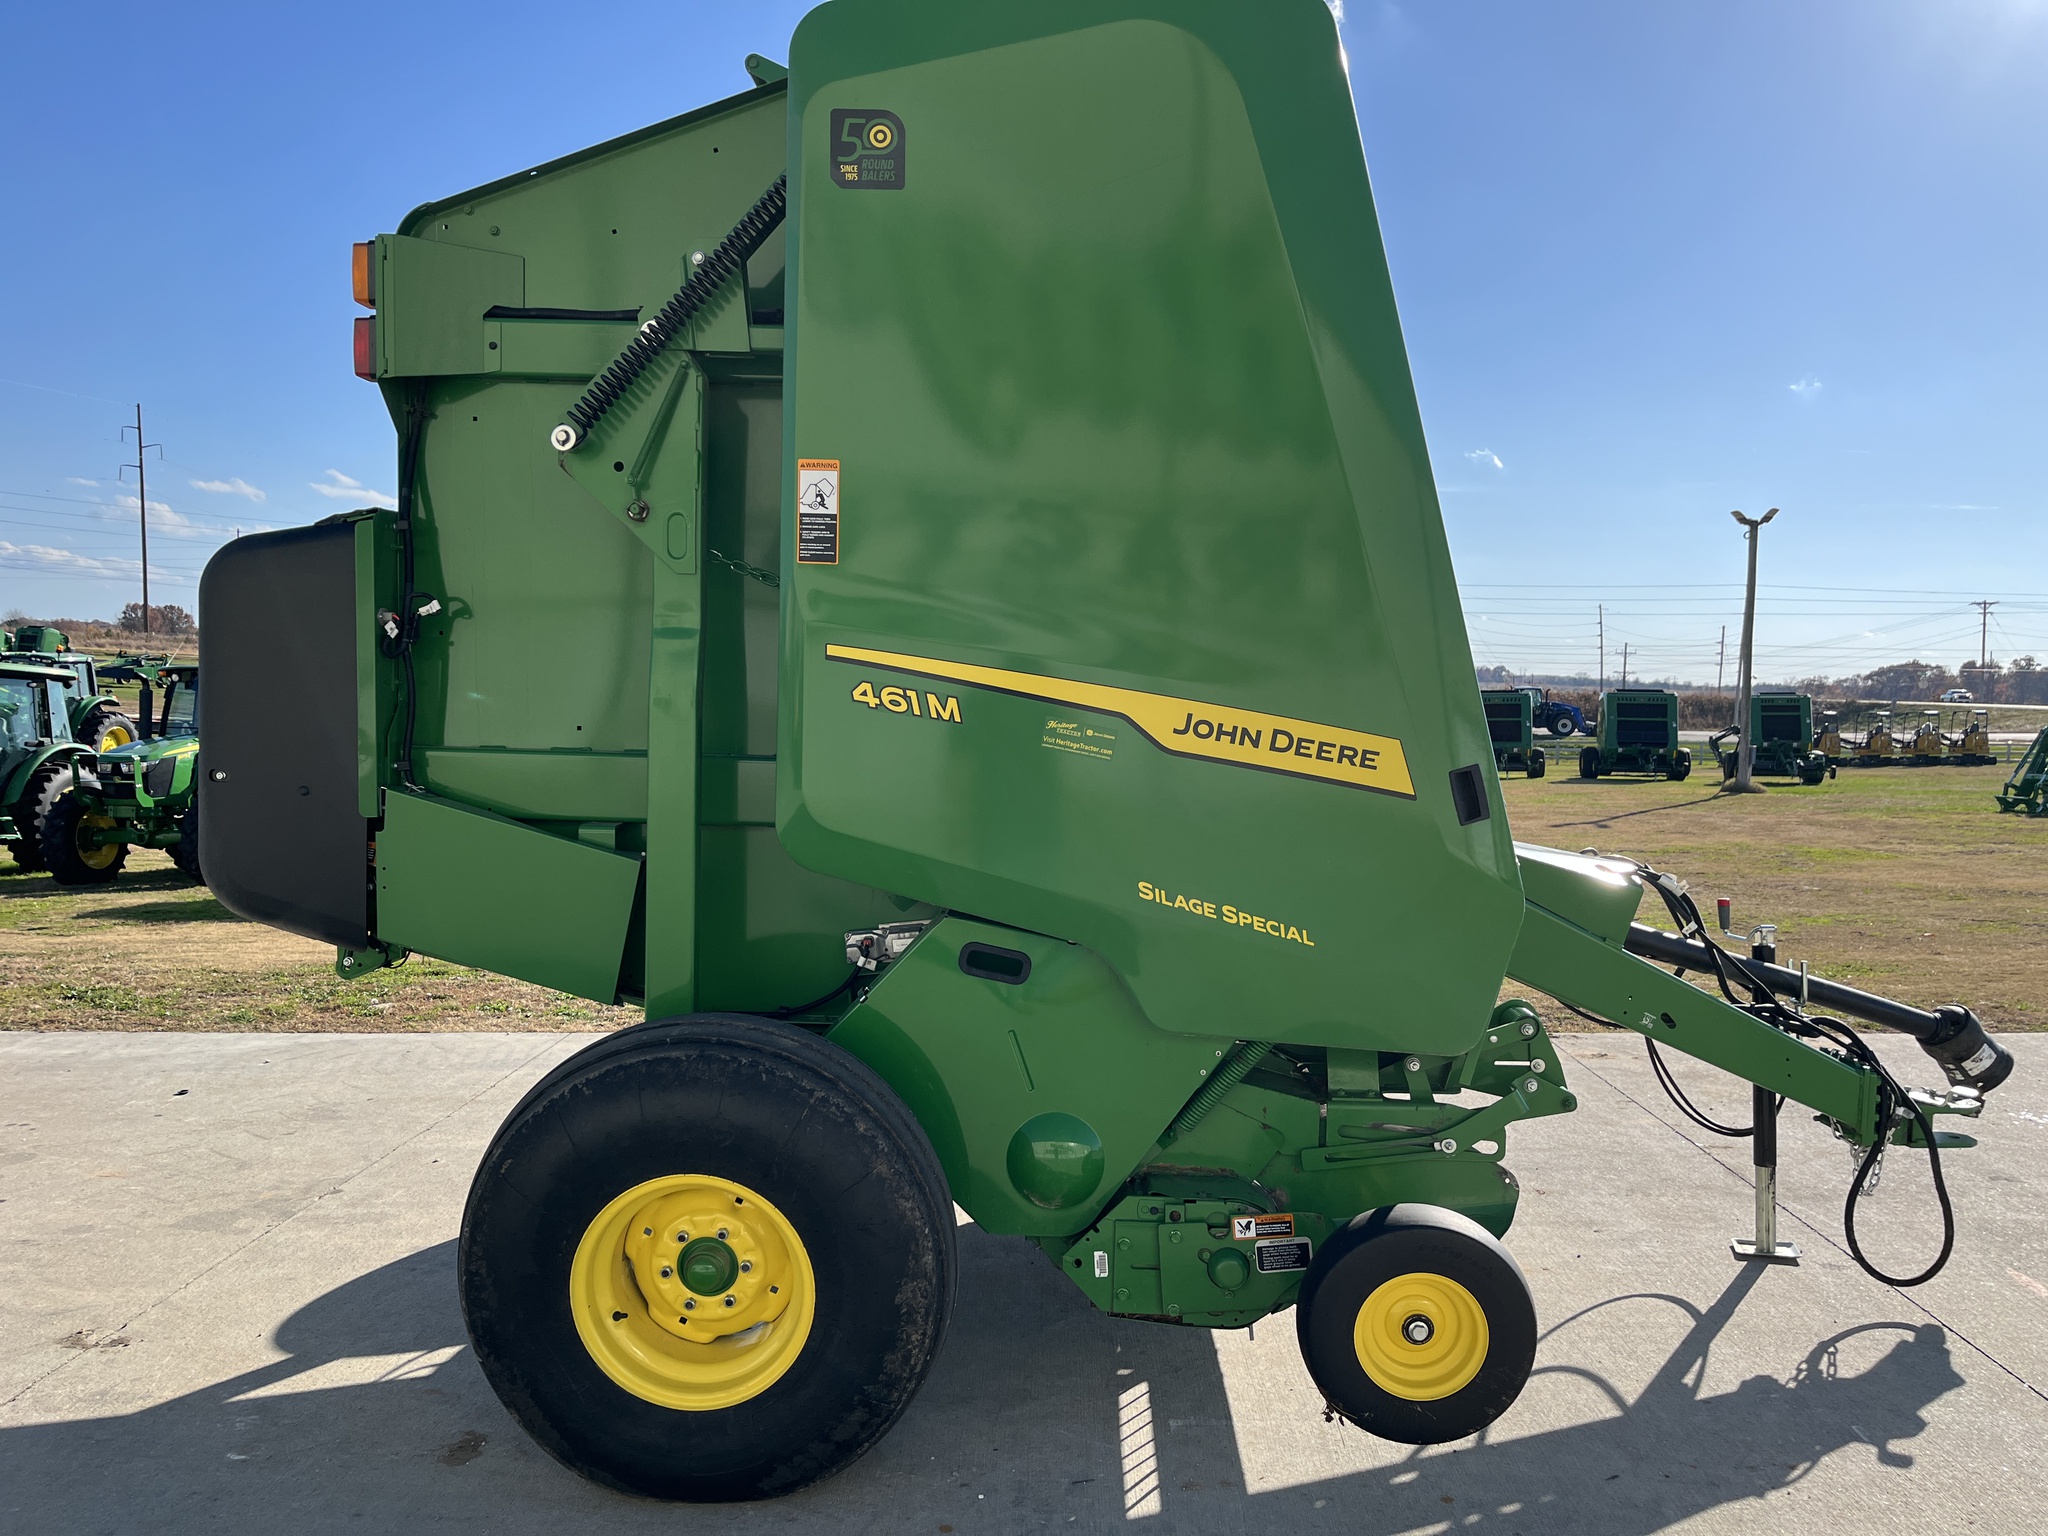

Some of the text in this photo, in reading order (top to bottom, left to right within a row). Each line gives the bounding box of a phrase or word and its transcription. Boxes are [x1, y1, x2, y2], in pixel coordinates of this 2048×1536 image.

[840, 164, 858, 173] SINCE
[862, 159, 894, 170] ROUND
[845, 173, 859, 181] 1975
[862, 170, 896, 181] BALERS
[1043, 735, 1056, 744] Visit
[1056, 737, 1113, 755] HeritageTractor.com
[1172, 712, 1381, 771] JOHN DEERE
[1137, 881, 1315, 947] SILAGE SPECIAL
